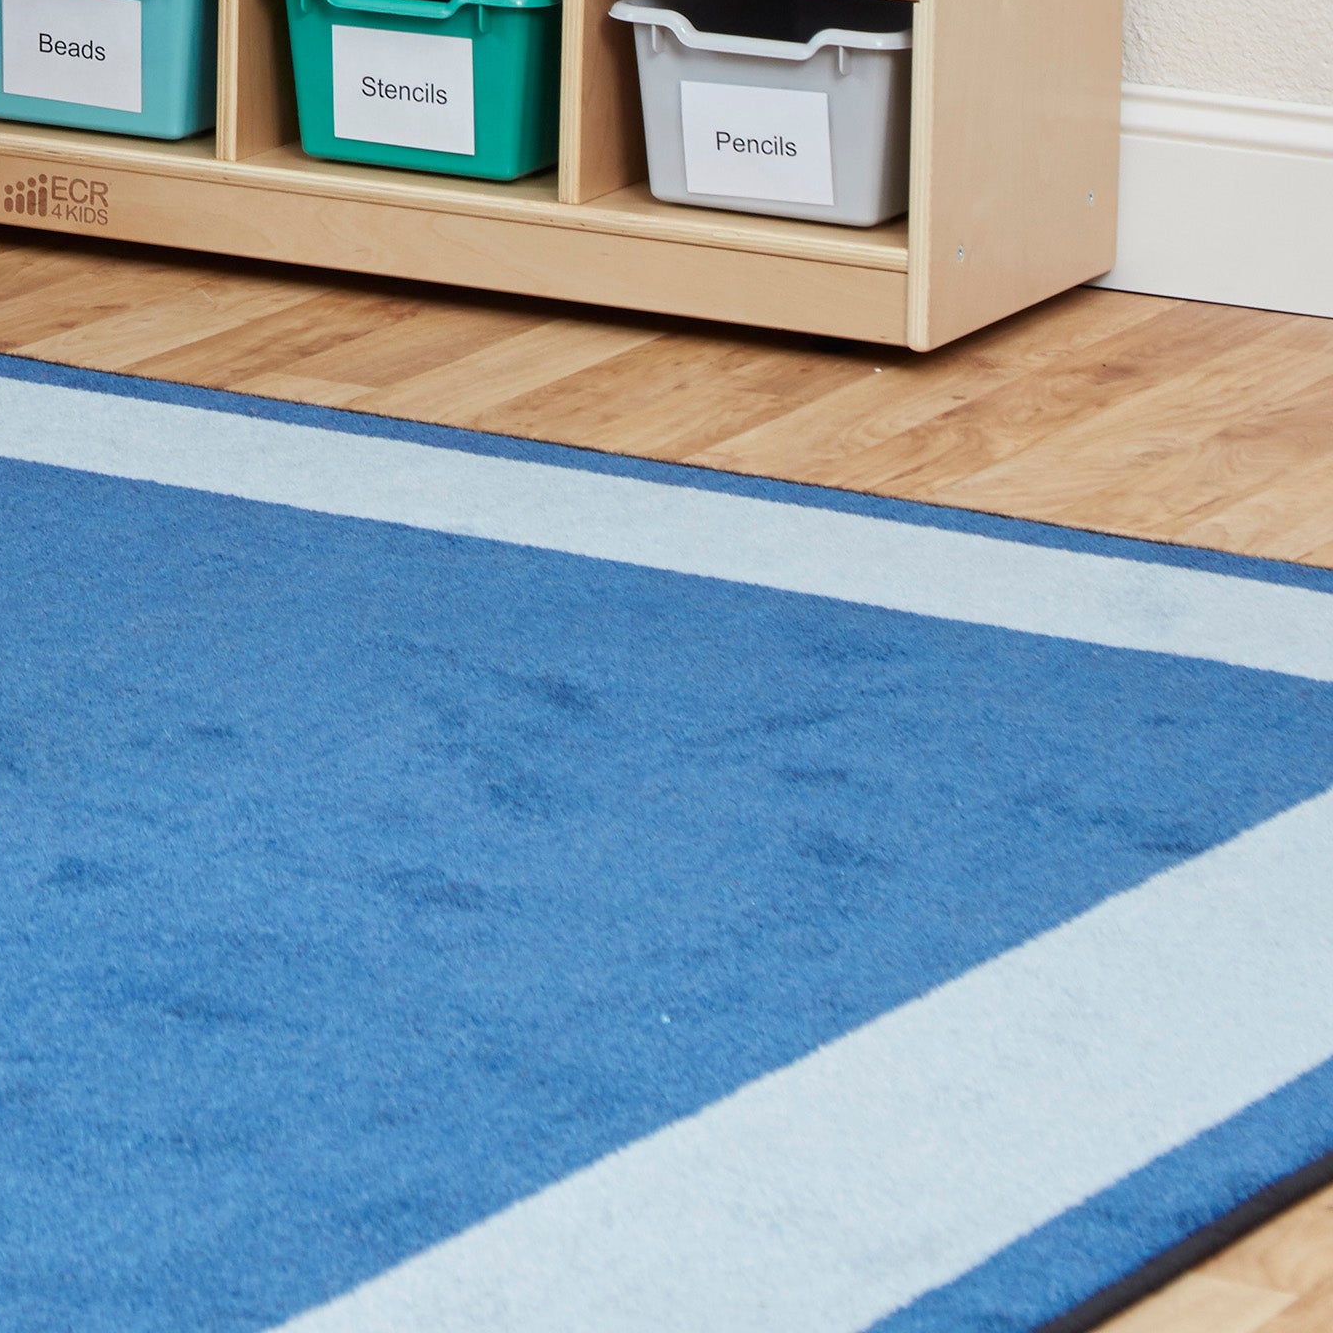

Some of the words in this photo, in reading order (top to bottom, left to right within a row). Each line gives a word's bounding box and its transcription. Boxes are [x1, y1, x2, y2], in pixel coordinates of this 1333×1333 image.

[39, 32, 106, 61] Beads
[361, 75, 448, 105] Stencils
[716, 130, 797, 156] Pencils
[51, 176, 109, 207] ECR
[51, 203, 62, 219] 4
[66, 204, 108, 226] KIDS
